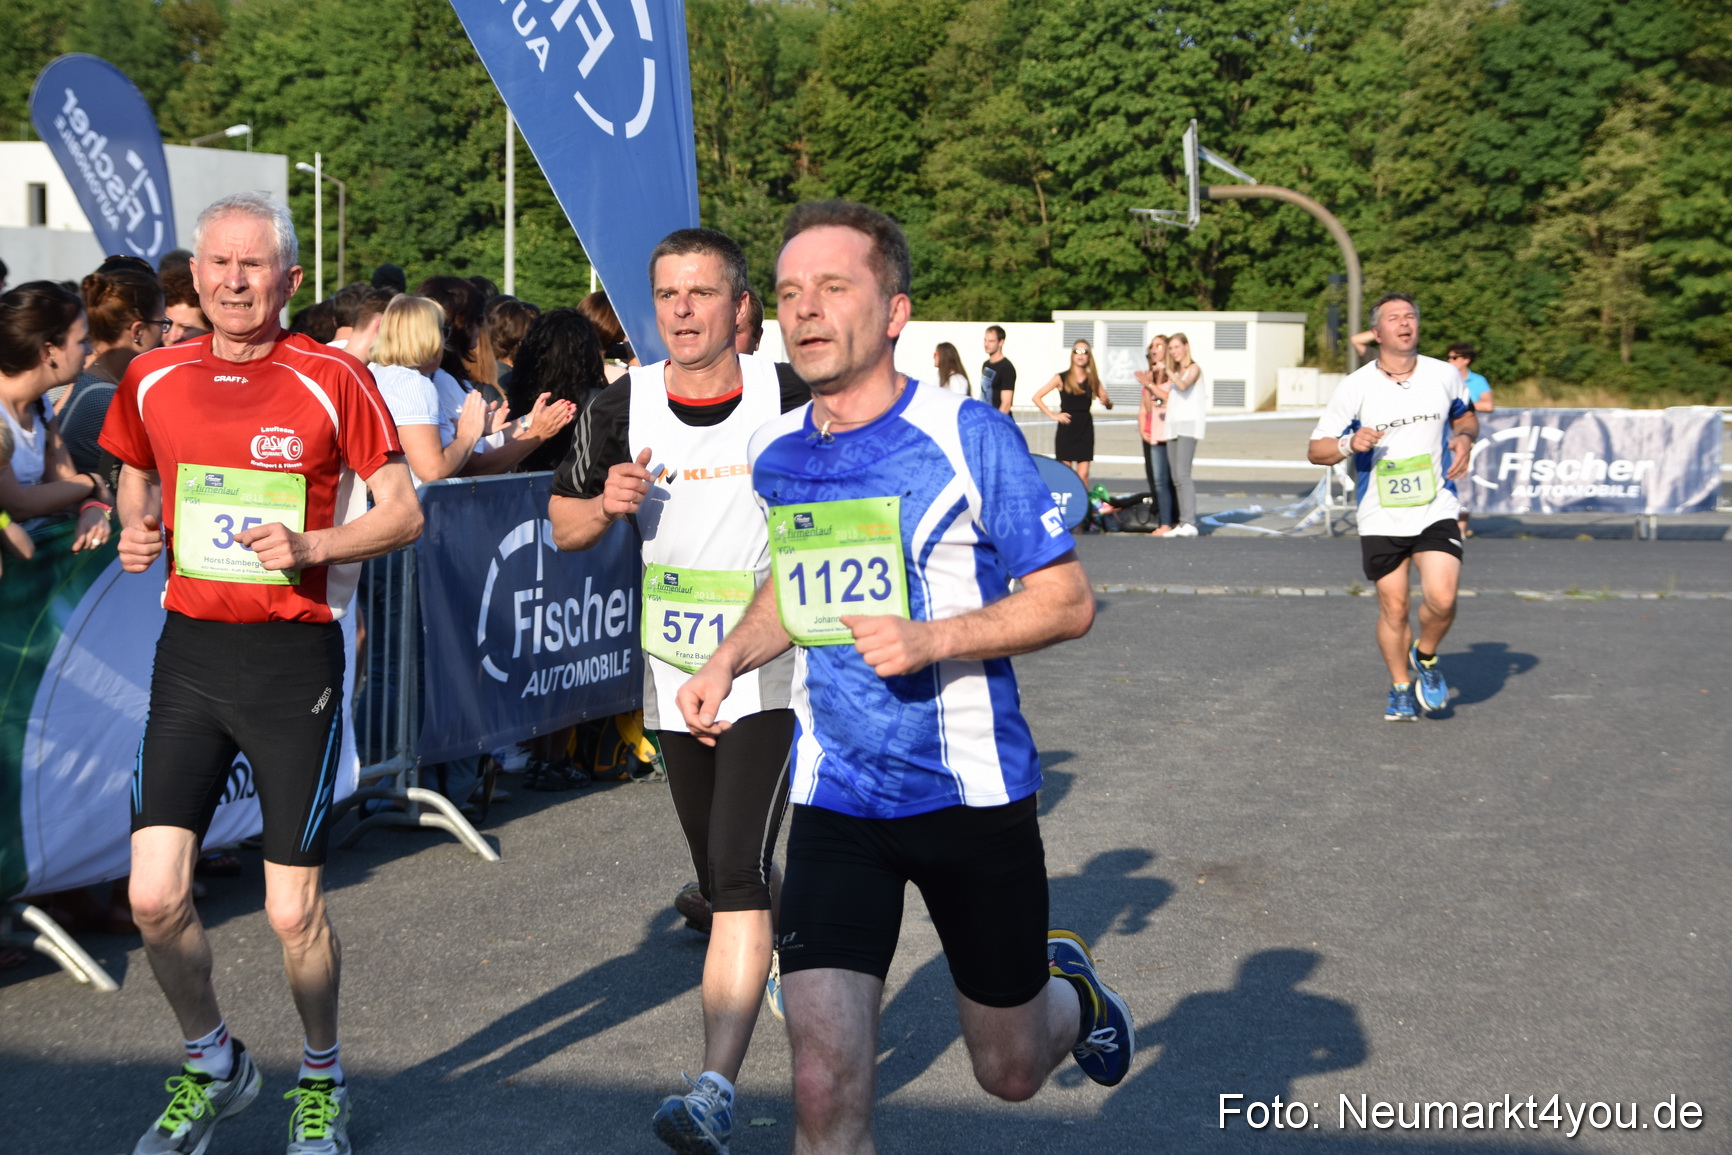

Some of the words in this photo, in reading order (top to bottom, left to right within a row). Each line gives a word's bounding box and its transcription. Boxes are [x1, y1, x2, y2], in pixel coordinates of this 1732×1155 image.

[213, 375, 242, 383] CRAFT
[1375, 413, 1441, 432] DELPHI
[260, 426, 295, 434] Laufteam
[250, 459, 277, 468] Kraftsport
[1497, 451, 1656, 481] Fischer
[195, 483, 240, 496] firmenlauf
[1388, 476, 1422, 494] 281
[1511, 484, 1641, 498] AUTOMOBILE
[212, 514, 263, 552] 35
[787, 525, 833, 539] firmenlauf
[203, 556, 225, 564] Horst
[657, 582, 693, 594] firmenlauf
[788, 556, 893, 606] 1123
[662, 610, 724, 646] 571
[676, 651, 694, 659] Franz
[694, 652, 711, 660] Bald
[521, 648, 632, 699] AUTOMOBILE
